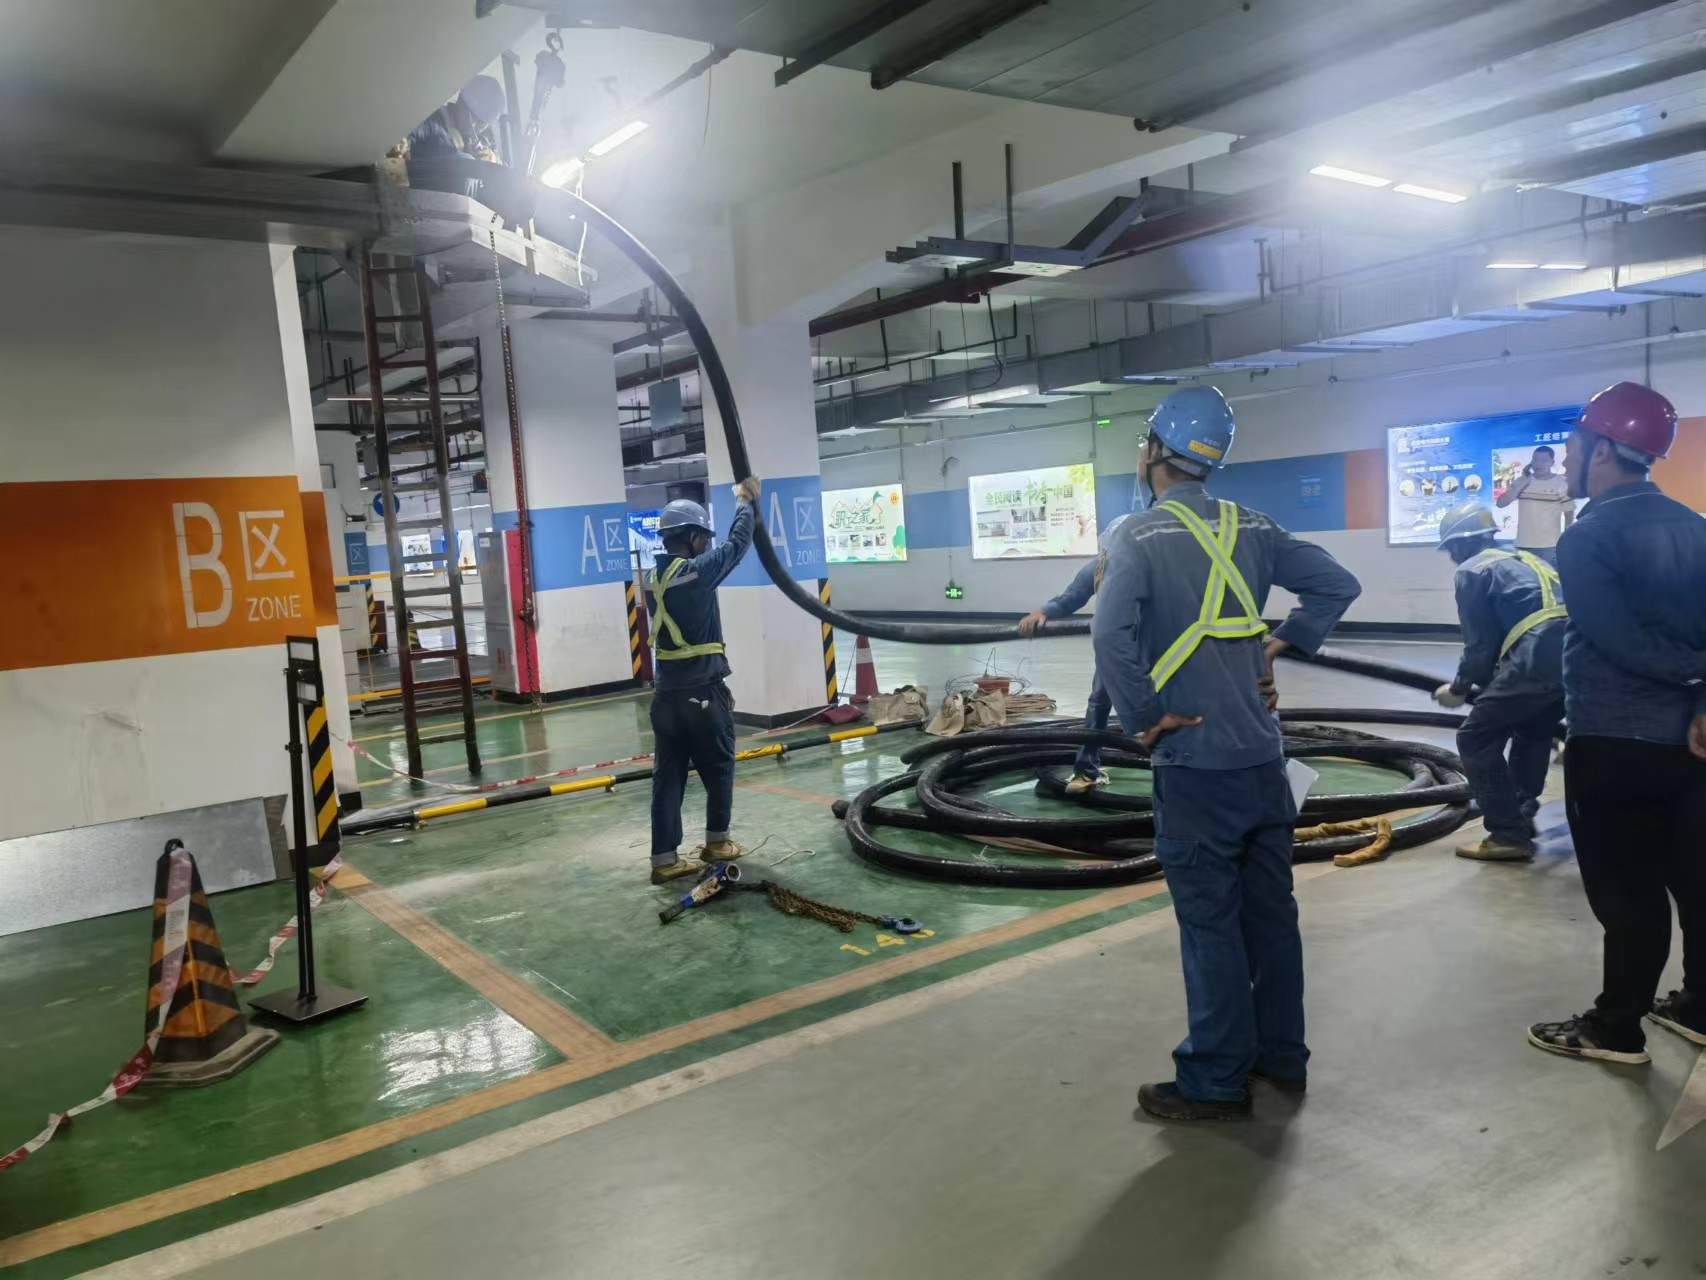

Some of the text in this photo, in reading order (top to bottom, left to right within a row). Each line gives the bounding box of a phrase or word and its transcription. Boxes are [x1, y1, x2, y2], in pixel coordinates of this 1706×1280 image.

[172, 502, 295, 629] B区
[581, 514, 625, 575] A区
[247, 595, 302, 622] ZONE
